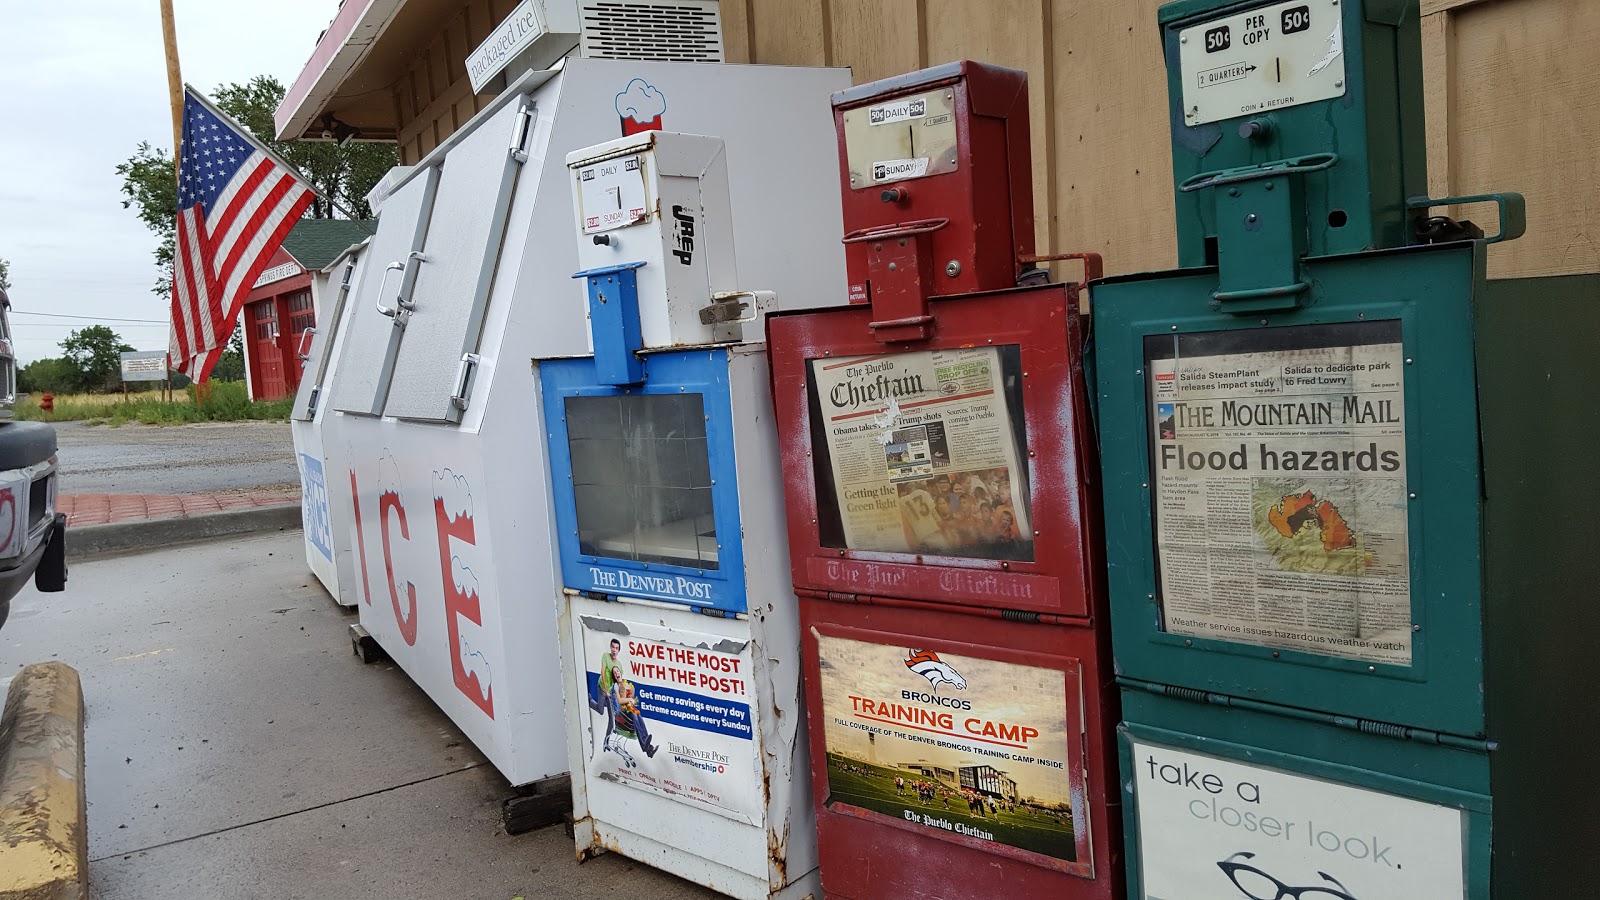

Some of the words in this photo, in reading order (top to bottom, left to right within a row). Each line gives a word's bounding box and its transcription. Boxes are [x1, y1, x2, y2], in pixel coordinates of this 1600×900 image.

[1246, 14, 1265, 30] PER
[1283, 11, 1309, 31] 50¢
[1207, 31, 1230, 49] 50¢
[1242, 28, 1270, 46] COPY
[471, 22, 516, 86] packaged
[516, 12, 535, 38] ice
[1200, 76, 1205, 84] 2
[1209, 66, 1245, 82] QUARTERS
[871, 110, 885, 121] 50¢
[886, 107, 908, 118] DAILY
[910, 104, 924, 114] 50¢
[1240, 104, 1256, 112] COIN
[1268, 96, 1295, 108] RETURN
[601, 166, 618, 176] DAILY
[886, 164, 914, 175] SUNDAY
[604, 212, 624, 222] SUNDAY
[276, 268, 286, 278] FIRE
[846, 367, 862, 378] The
[865, 360, 894, 376] Pueblo
[953, 360, 988, 372] RECYCLING
[1285, 366, 1312, 374] Salida
[1326, 363, 1365, 373] dedicate
[1368, 362, 1391, 372] park
[937, 372, 960, 380] DROP
[1180, 372, 1206, 381] Salida
[1209, 370, 1260, 379] SteamPlant
[1297, 377, 1316, 385] Fred
[1318, 377, 1347, 385] Lowry
[830, 369, 924, 410] Chieftain
[1181, 382, 1215, 391] releases
[1218, 381, 1250, 390] impact
[1250, 379, 1274, 388] study
[946, 408, 968, 416] Sources:
[969, 404, 988, 413] Trump
[948, 416, 968, 424] coming
[976, 412, 994, 420] Pueblo
[1176, 402, 1214, 428] THE
[1221, 400, 1333, 427] MOUNTAIN
[1342, 396, 1400, 424] MAIL
[833, 426, 858, 435] Obama
[858, 423, 877, 432] takes
[897, 416, 922, 425] Trump
[1162, 444, 1248, 470] Flood
[1260, 442, 1400, 471] hazards
[844, 487, 879, 500] Getting
[880, 485, 895, 496] the
[846, 502, 874, 512] Green
[876, 499, 897, 512] light
[827, 561, 859, 582] The
[347, 447, 495, 721] ICE
[590, 568, 617, 587] THE
[618, 570, 675, 594] DENVER
[676, 577, 712, 599] POST
[1171, 616, 1207, 628] Weather
[1210, 621, 1241, 632] service
[1243, 626, 1272, 636] issues
[1274, 629, 1325, 643] hazardous
[1327, 636, 1369, 648] weather
[1373, 642, 1405, 651] watch
[629, 641, 665, 660] SAVE
[666, 648, 695, 665] THE
[698, 652, 740, 673] MOST
[630, 660, 666, 680] WITH
[668, 667, 697, 686] THE
[700, 674, 745, 695] POST!
[640, 689, 653, 700] Get
[654, 694, 675, 704] more
[675, 697, 705, 712] savings
[706, 704, 728, 716] every
[729, 708, 745, 720] day
[901, 690, 972, 710] BRONCOS
[641, 702, 669, 714] Extreme
[670, 709, 700, 722] coupons
[700, 715, 721, 727] every
[722, 719, 750, 733] Sunday
[848, 695, 953, 730] TRAINING
[964, 718, 1039, 743] CAMP
[667, 741, 682, 754] THE
[682, 745, 710, 759] DENVER
[711, 751, 729, 764] POST
[834, 718, 849, 727] FULL
[850, 720, 883, 734] COVERAGE
[884, 728, 892, 736] OF
[894, 731, 907, 739] THE
[908, 734, 936, 746] DENVER
[937, 741, 972, 753] BRONCOS
[973, 747, 1011, 760] TRAINING
[1012, 754, 1035, 764] CAMP
[1037, 758, 1063, 770] INSIDE
[674, 755, 717, 774] Membership
[618, 767, 632, 776] PRINT
[638, 772, 657, 784] ONLINE
[664, 780, 682, 790] MOBILE
[690, 786, 703, 795] APPS
[1146, 756, 1224, 794] take
[1236, 781, 1260, 804] a
[904, 809, 921, 823] The
[923, 813, 952, 831] Pueblo
[955, 822, 994, 841] Chieftain
[1189, 797, 1295, 840] closer
[1308, 820, 1402, 869] look.
